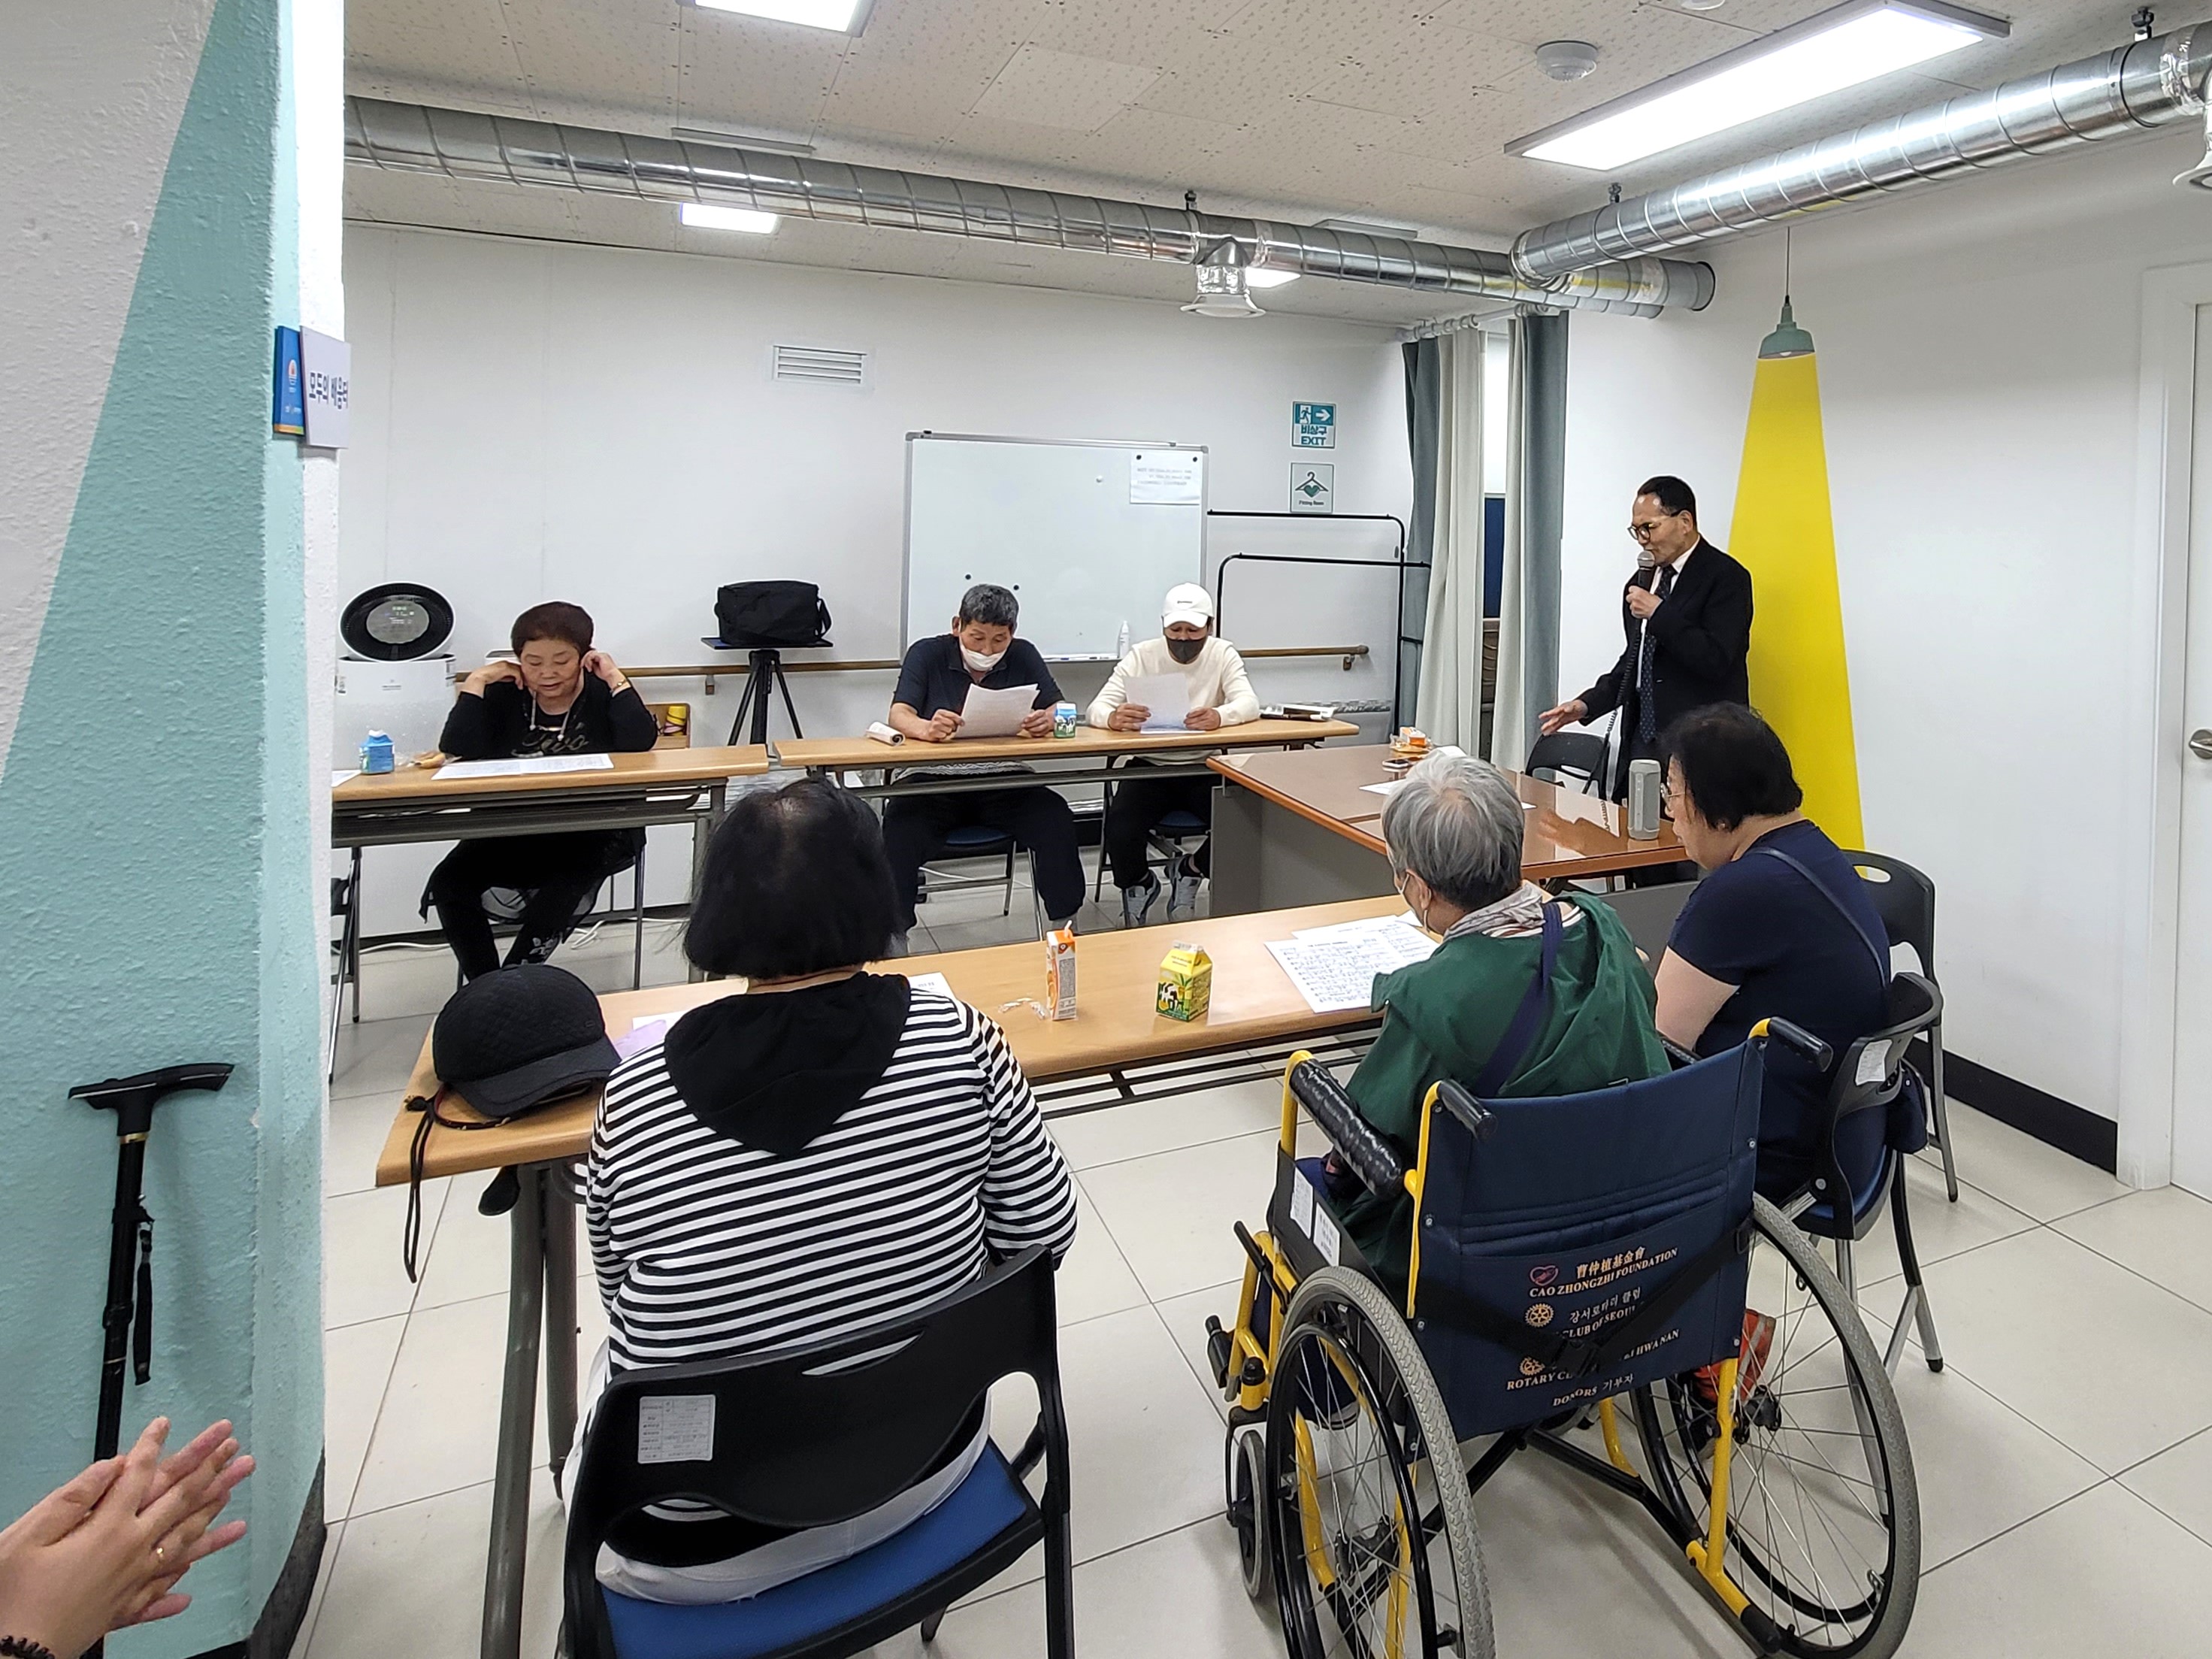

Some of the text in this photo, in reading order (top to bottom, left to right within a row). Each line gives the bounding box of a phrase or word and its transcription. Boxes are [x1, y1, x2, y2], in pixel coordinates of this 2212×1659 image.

[309, 372, 329, 404] 모두의
[1300, 424, 1327, 435] 비상구
[1301, 436, 1327, 446] EXIT
[1529, 1247, 1678, 1297] CAO ZHONGZHI FOUNDATION
[1506, 1372, 1556, 1391] ROTARY
[1552, 1373, 1635, 1407] DONORS 기부자
